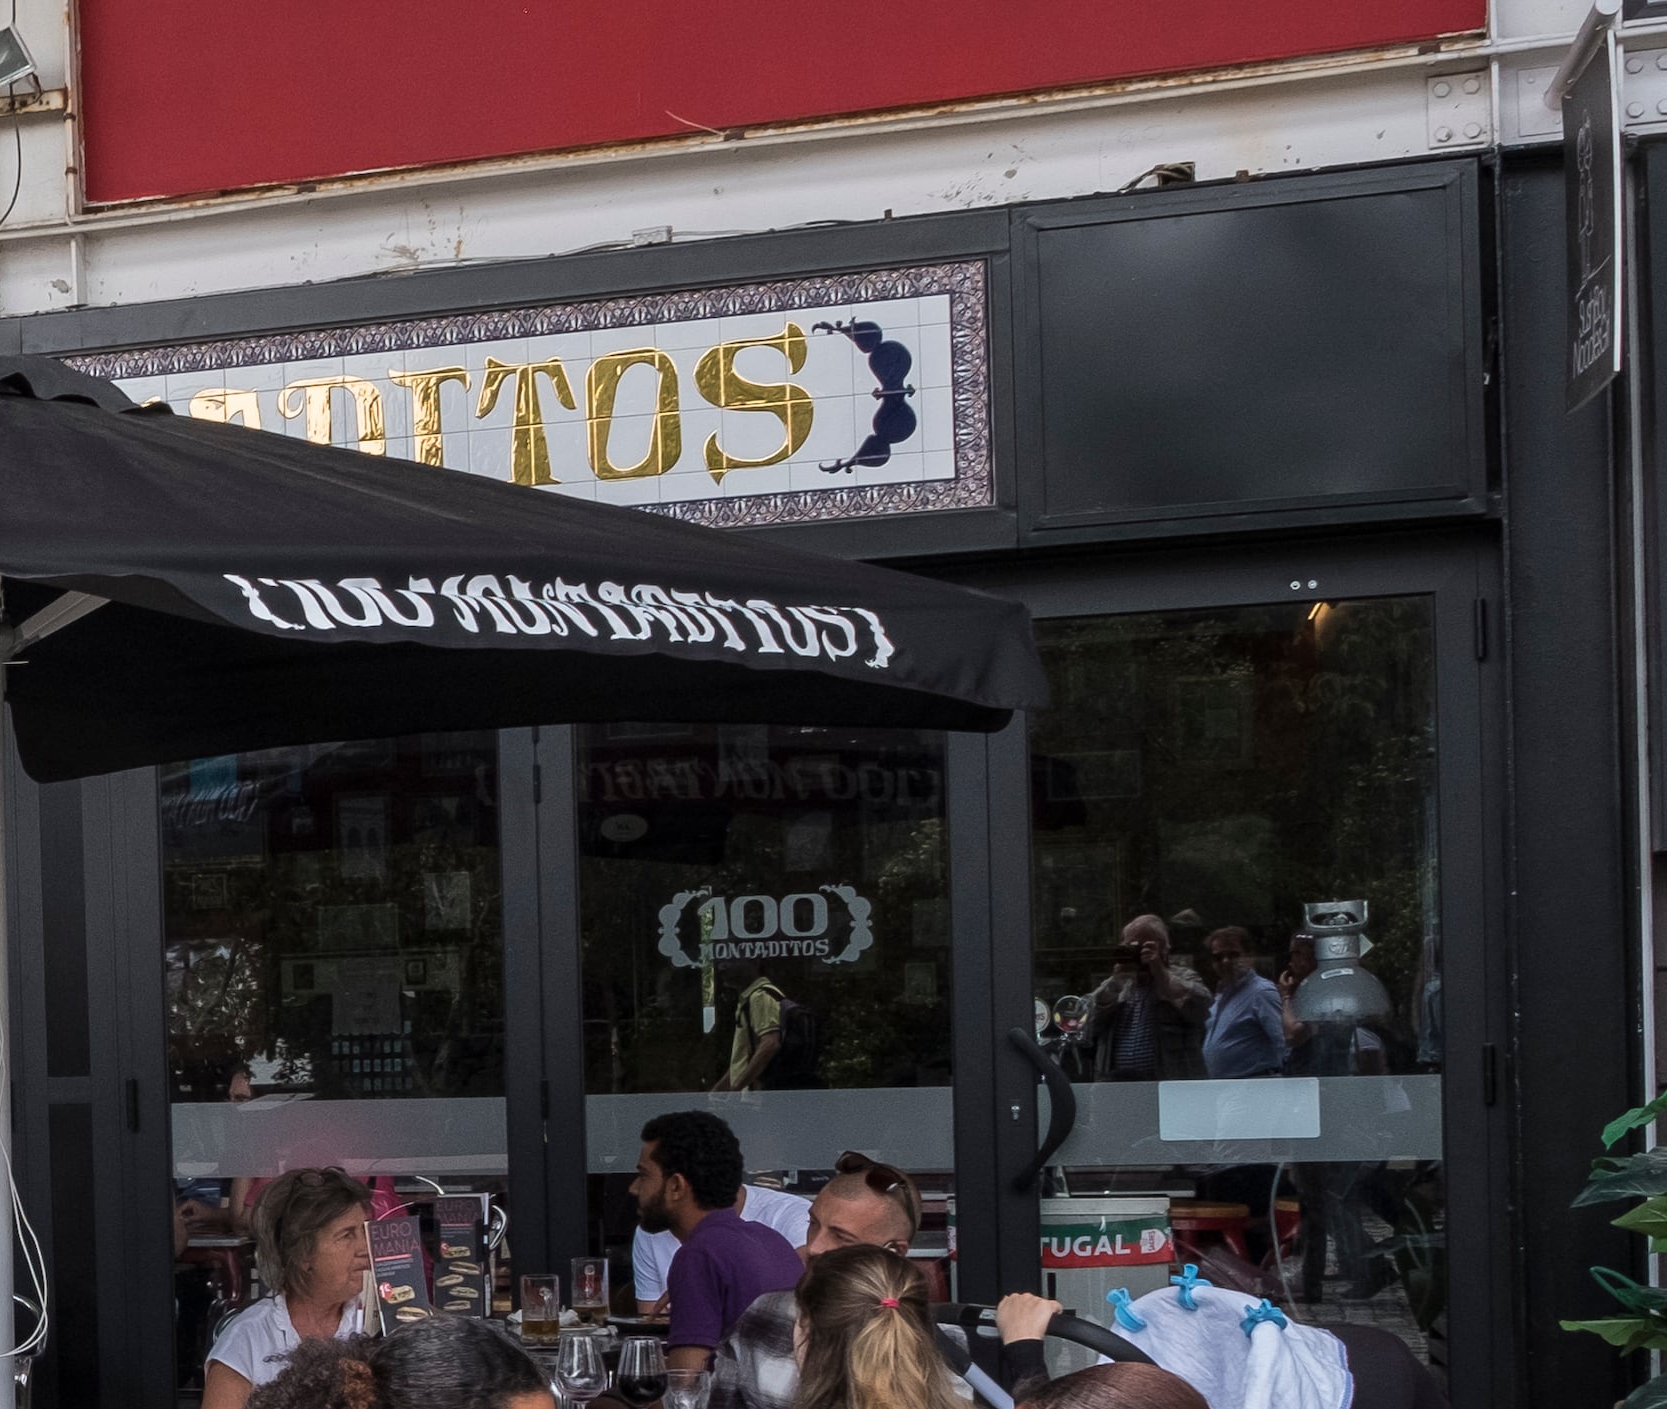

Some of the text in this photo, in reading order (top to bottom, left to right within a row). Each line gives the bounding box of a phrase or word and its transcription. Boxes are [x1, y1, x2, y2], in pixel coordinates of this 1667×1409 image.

[697, 893, 829, 940] 100
[698, 939, 830, 961] MONTADITOS
[370, 1221, 412, 1241] EURO
[373, 1238, 422, 1257] MANIA
